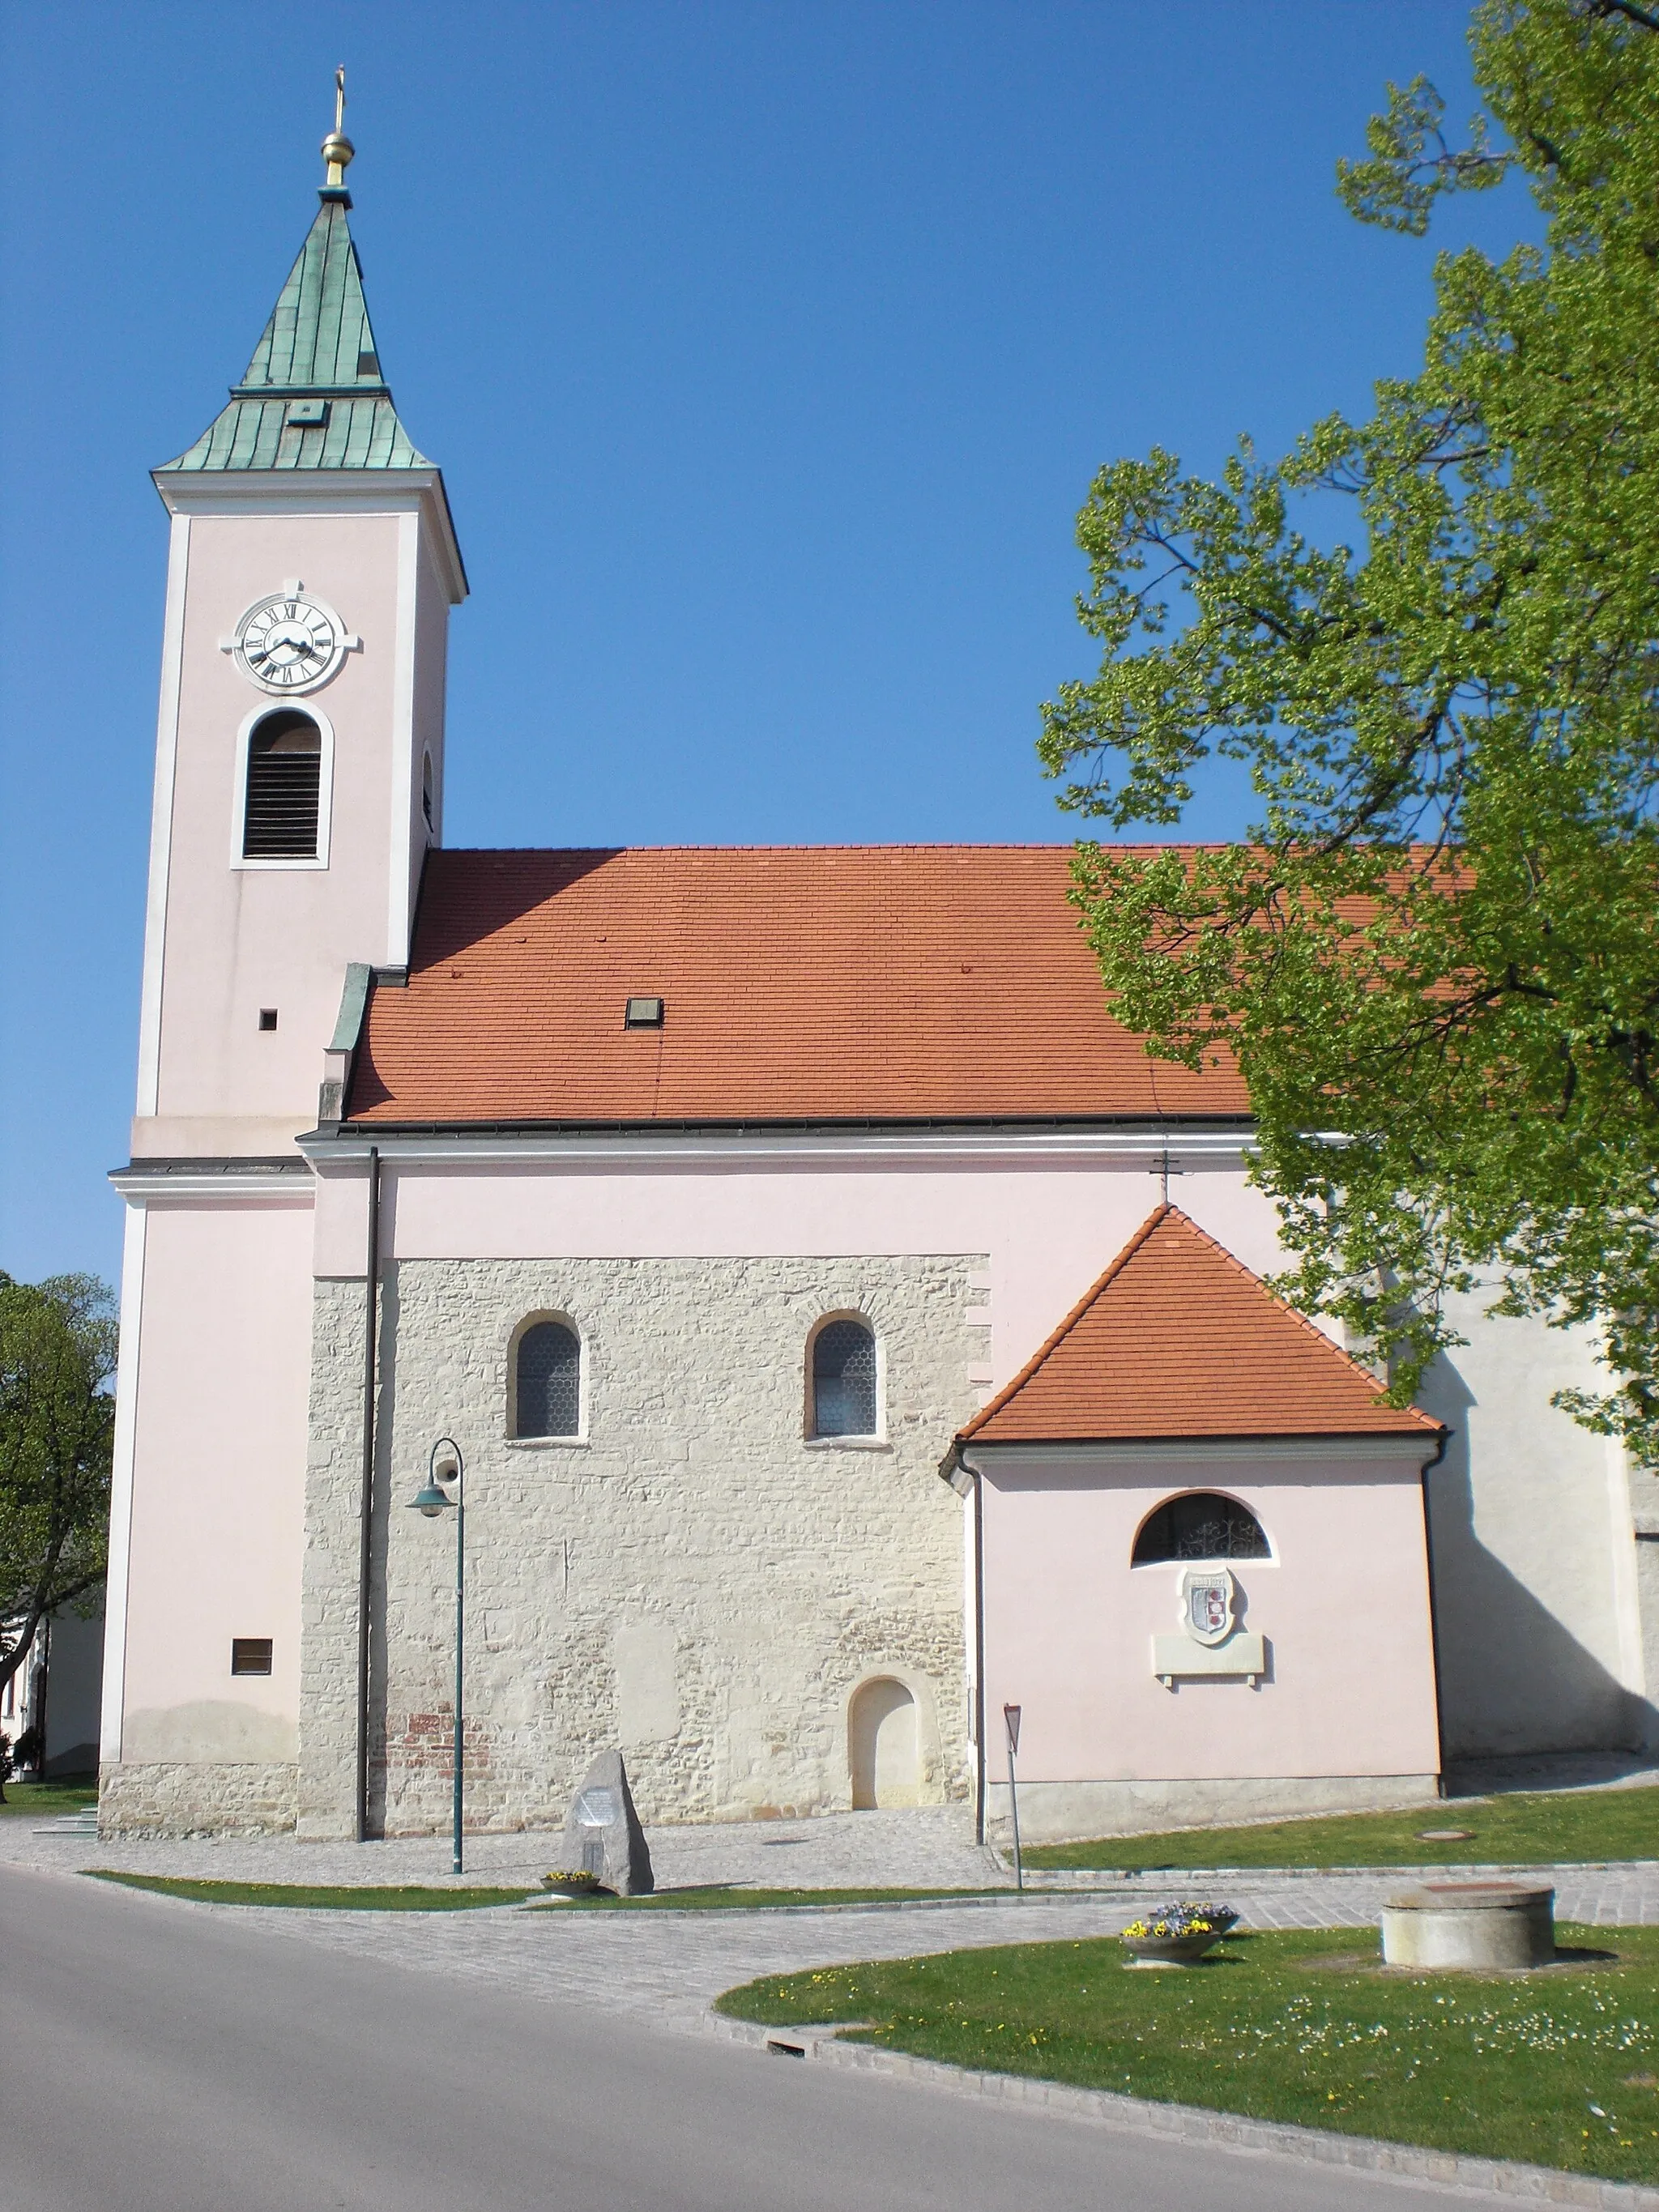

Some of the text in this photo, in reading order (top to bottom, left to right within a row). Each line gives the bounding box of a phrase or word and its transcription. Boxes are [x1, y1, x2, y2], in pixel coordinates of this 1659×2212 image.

[264, 607, 279, 624] XI
[284, 604, 297, 620] XII
[302, 608, 312, 622] I
[251, 621, 267, 634] X
[246, 639, 262, 647] IX
[283, 667, 292, 683] VI
[301, 664, 311, 679] V
